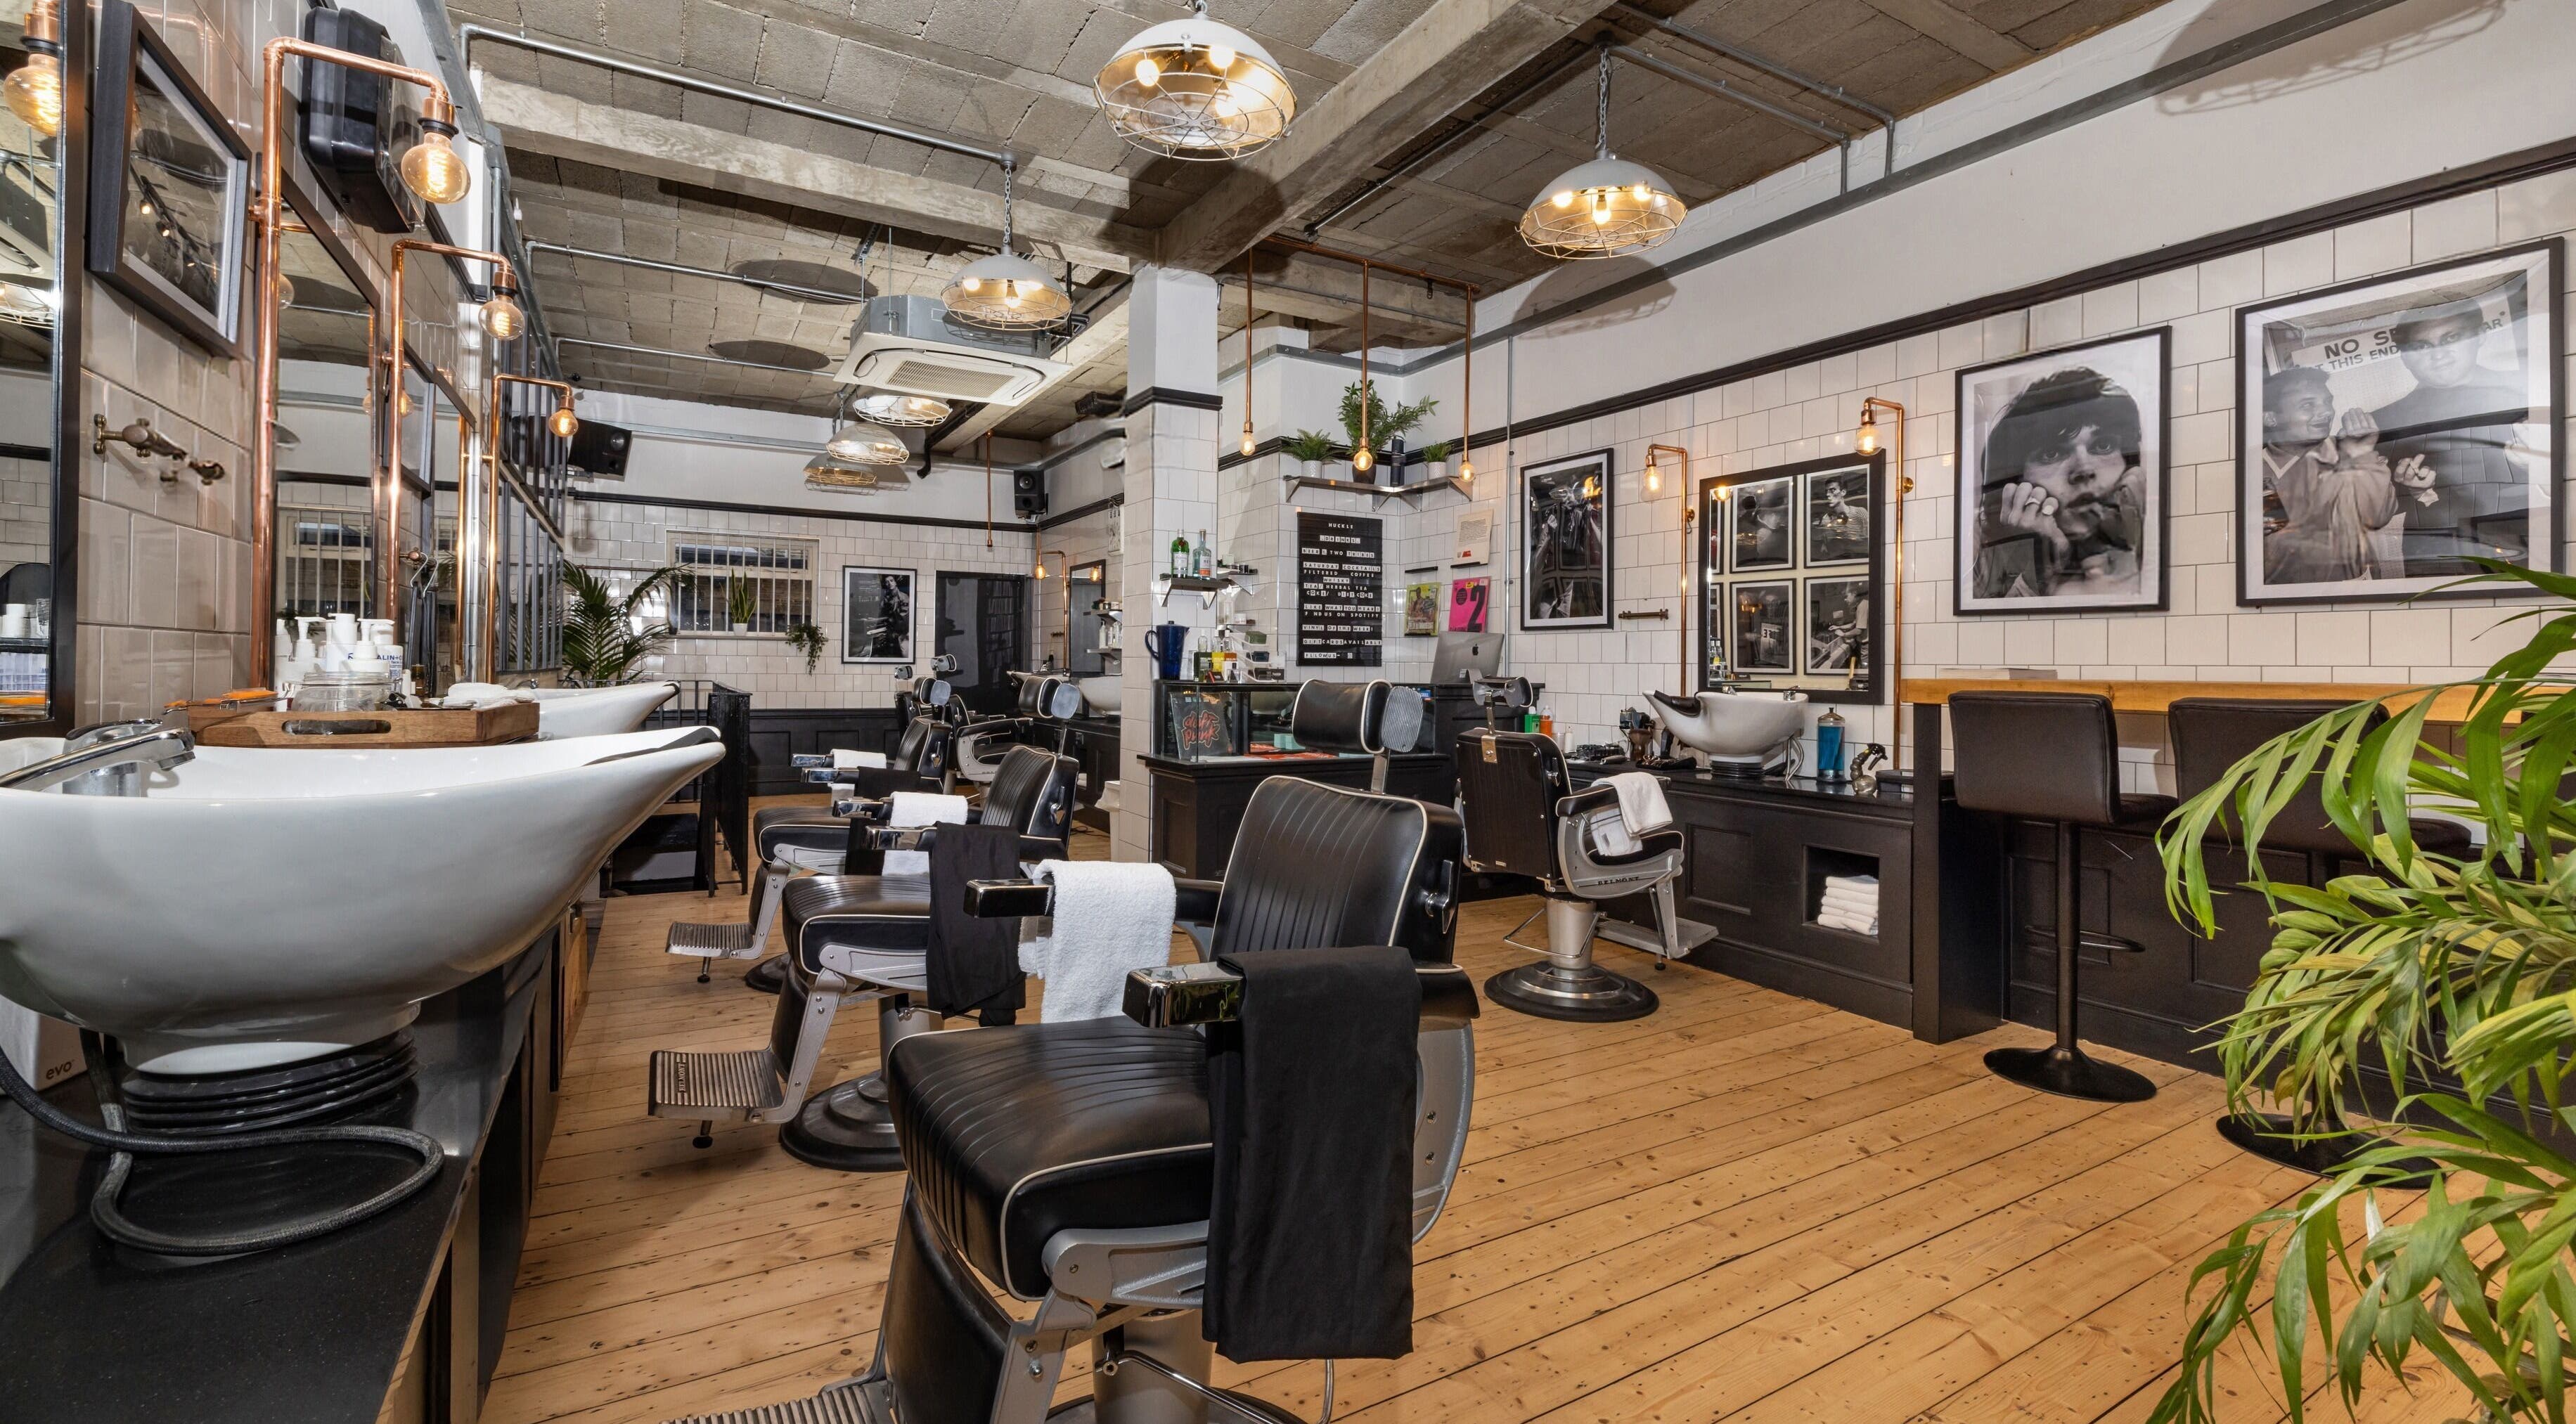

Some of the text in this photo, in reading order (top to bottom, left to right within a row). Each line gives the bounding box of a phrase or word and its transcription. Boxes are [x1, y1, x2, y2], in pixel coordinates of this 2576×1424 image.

[2324, 339, 2359, 359] NO
[2328, 354, 2364, 370] THIS
[2369, 345, 2400, 360] END
[1342, 564, 1381, 572] COCKTAILS
[1598, 876, 1640, 886] BELMONT
[46, 1061, 72, 1080] evo
[678, 1063, 687, 1093] BELMONT
